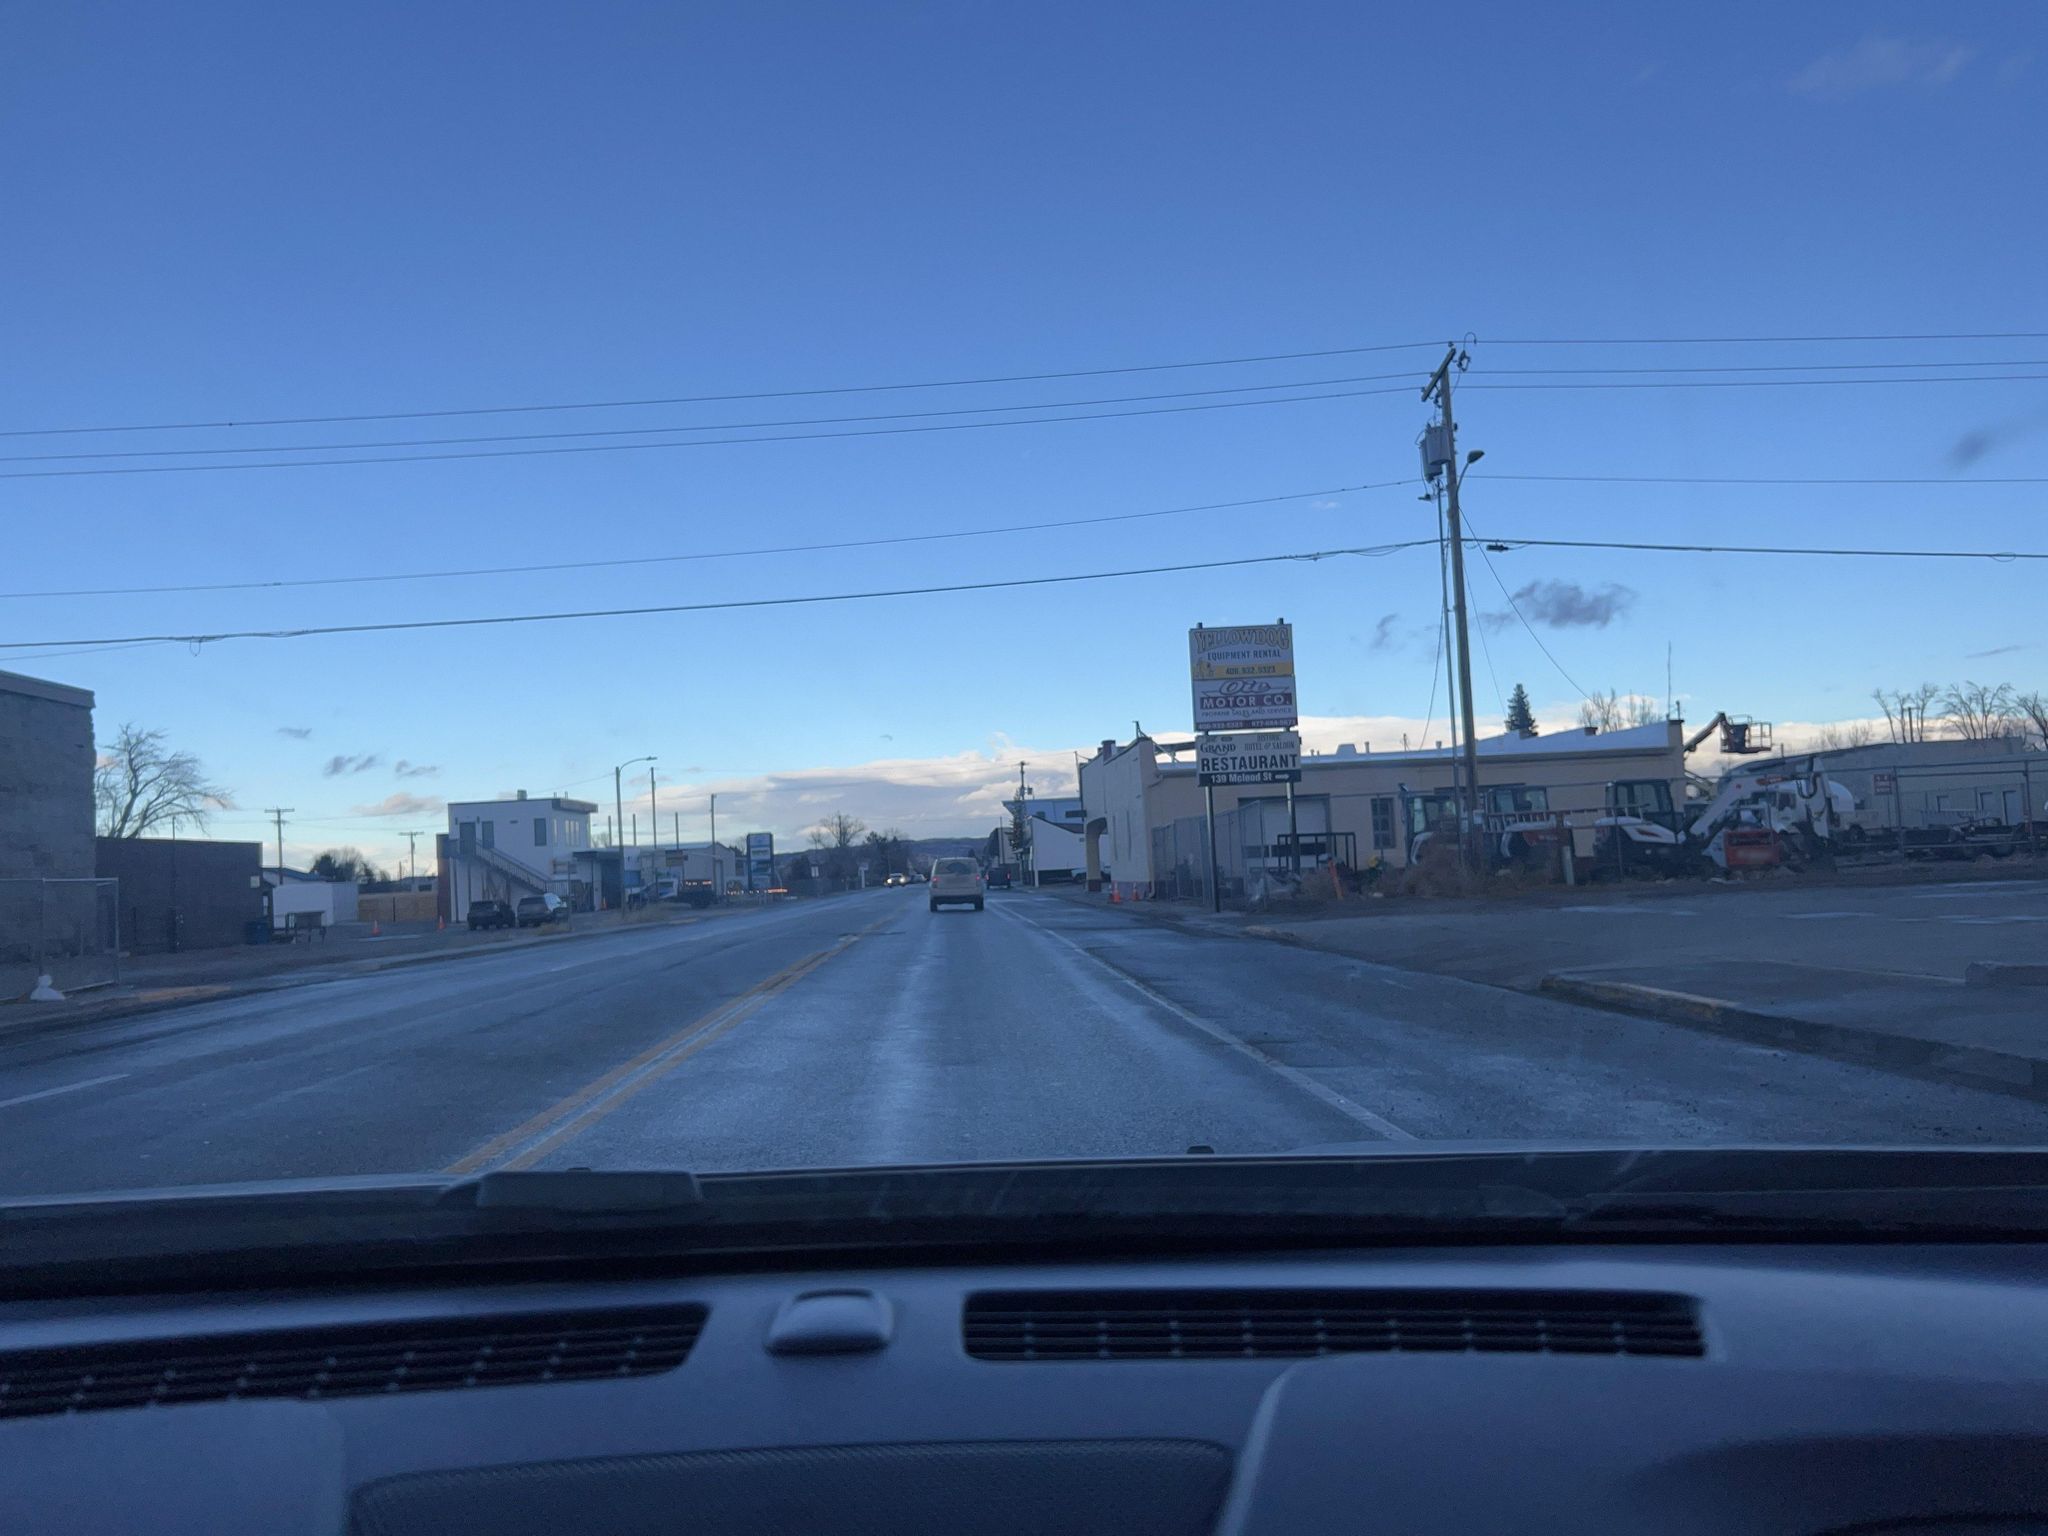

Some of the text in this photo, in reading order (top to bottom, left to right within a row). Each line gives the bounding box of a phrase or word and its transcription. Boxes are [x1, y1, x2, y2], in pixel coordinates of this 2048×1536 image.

[1207, 649, 1281, 661] EQUIPMENT RENTAL
[1203, 694, 1290, 708] MOTOR CO.
[1200, 743, 1236, 756] GRAND
[1201, 754, 1298, 772] RESTAURANT
[1211, 774, 1227, 783] 139
[1263, 772, 1272, 781] St
